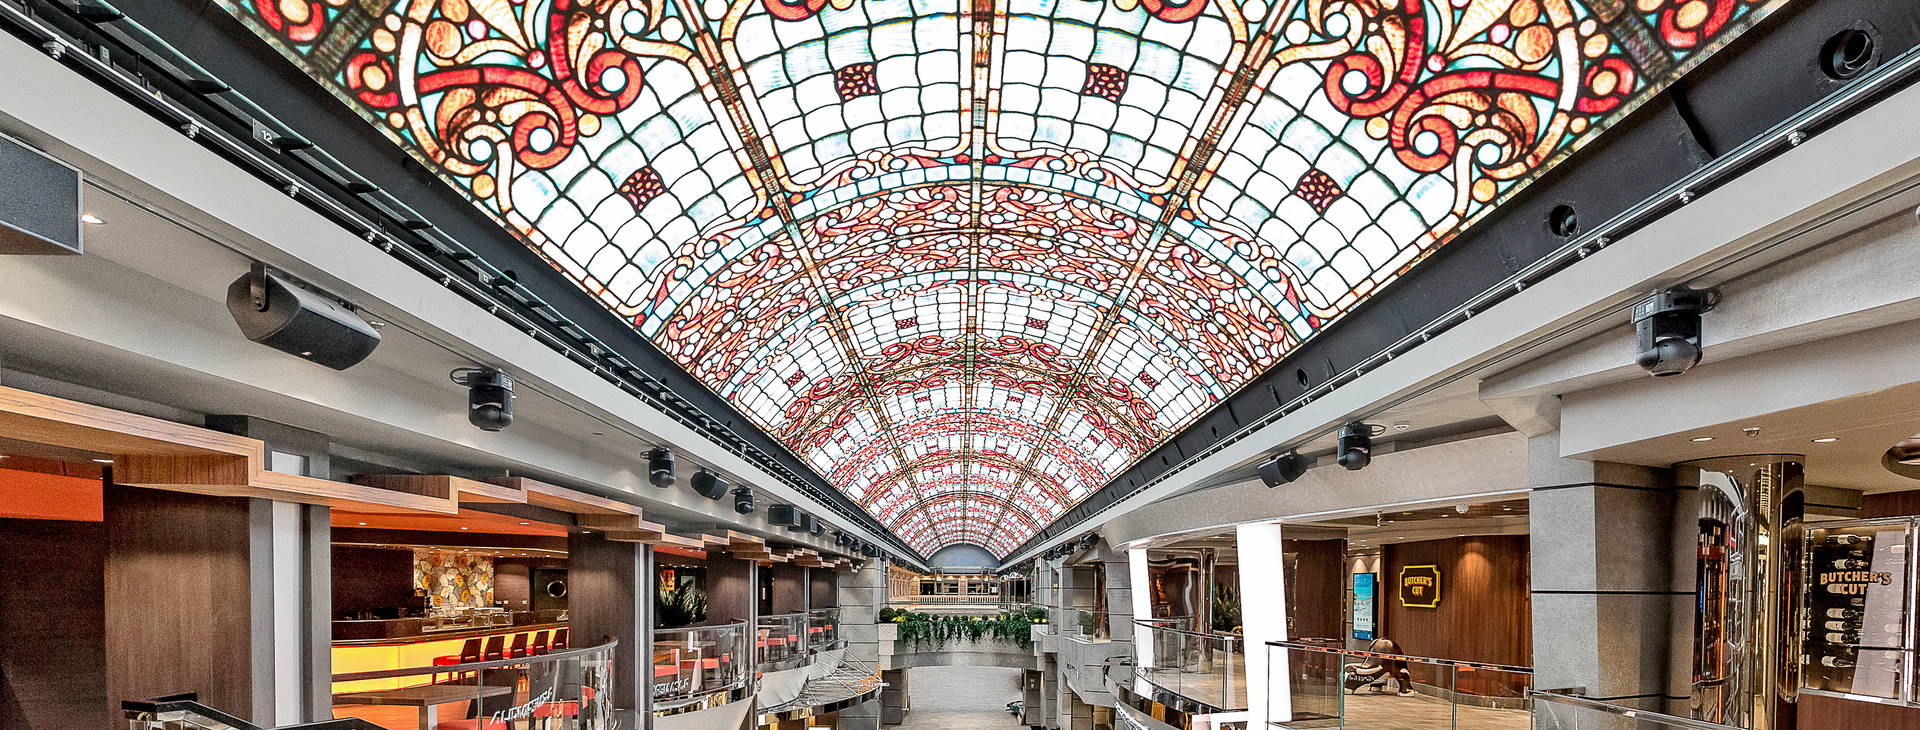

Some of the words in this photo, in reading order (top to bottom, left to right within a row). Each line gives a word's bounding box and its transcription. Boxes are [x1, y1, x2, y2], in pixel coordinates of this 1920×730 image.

[261, 130, 273, 144] 12
[1404, 576, 1433, 587] BUTCHER'S
[1820, 571, 1892, 585] BUTCHER'S
[1412, 586, 1424, 596] CUT
[1840, 583, 1867, 595] CUT
